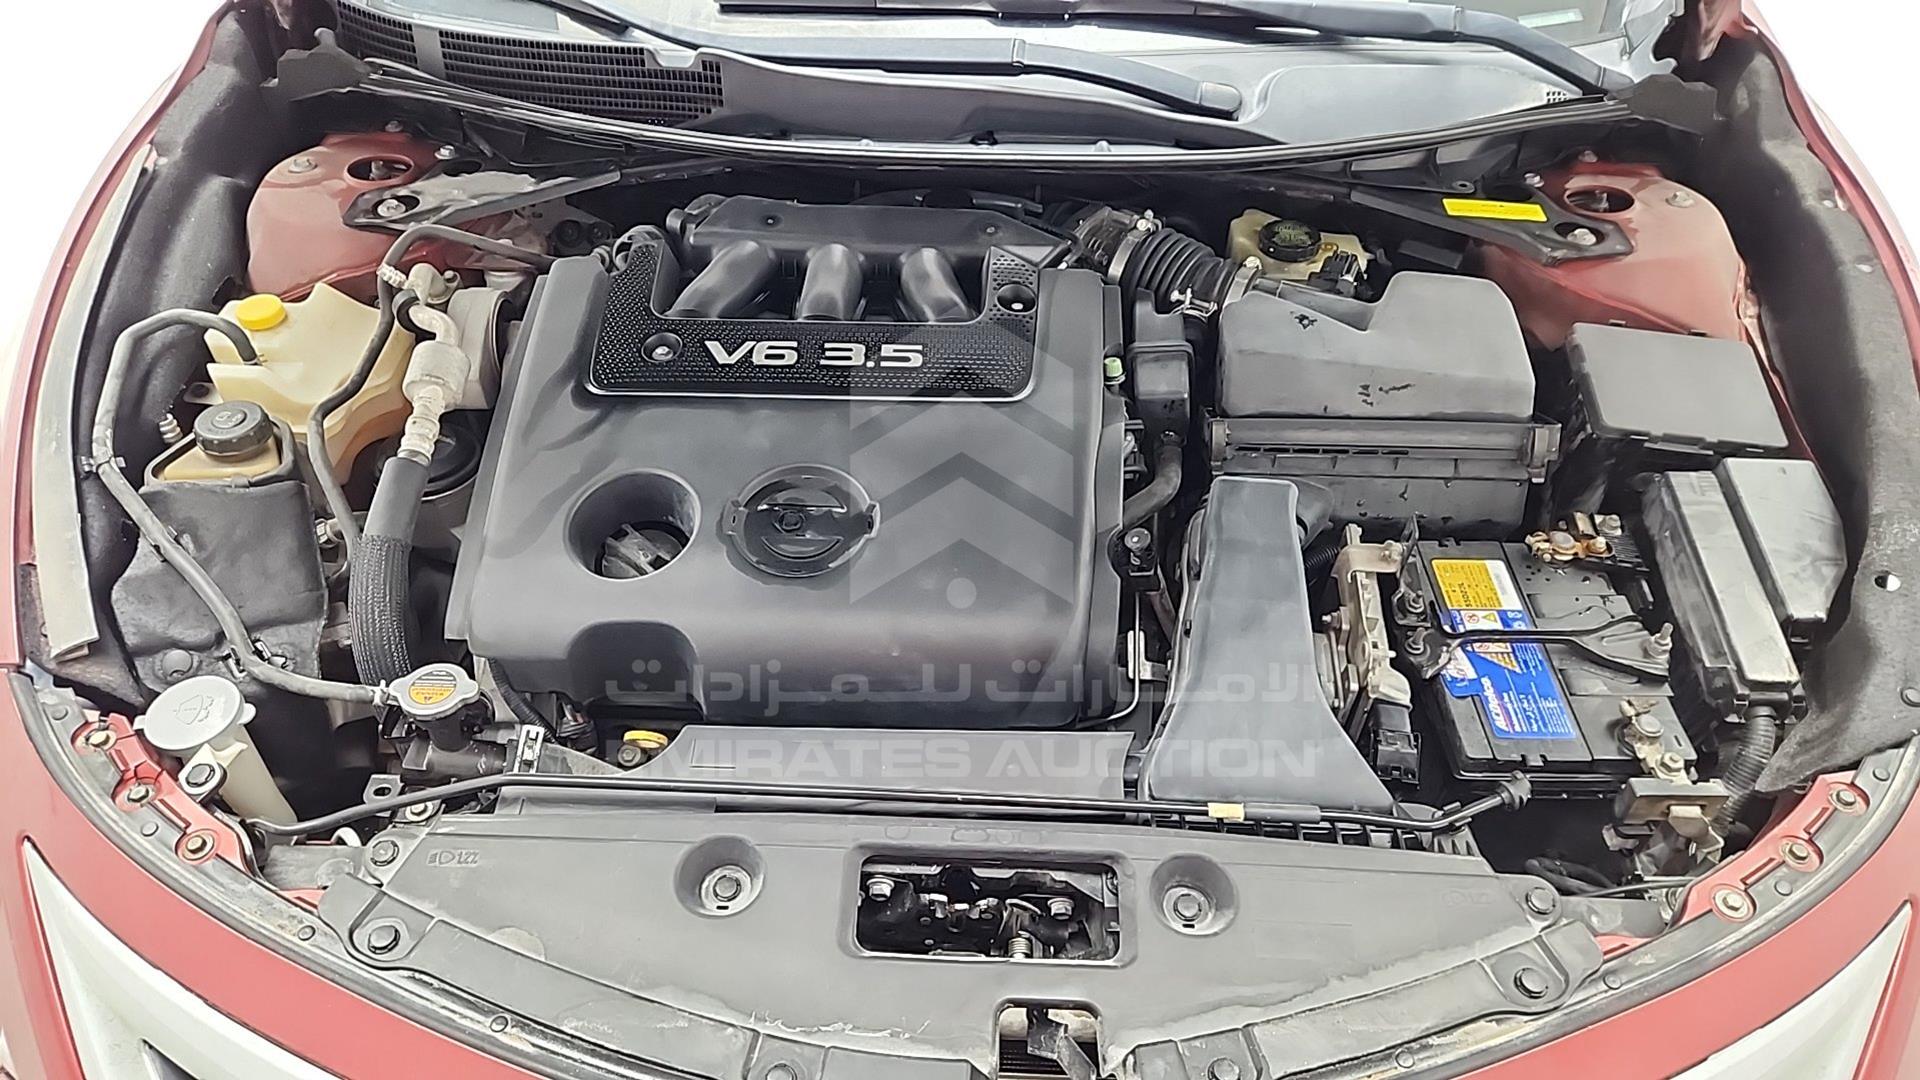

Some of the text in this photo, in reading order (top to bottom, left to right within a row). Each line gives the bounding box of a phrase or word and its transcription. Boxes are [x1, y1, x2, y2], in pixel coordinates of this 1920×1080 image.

[704, 341, 923, 368] V6 3.5
[1480, 675, 1510, 732] ACDelco
